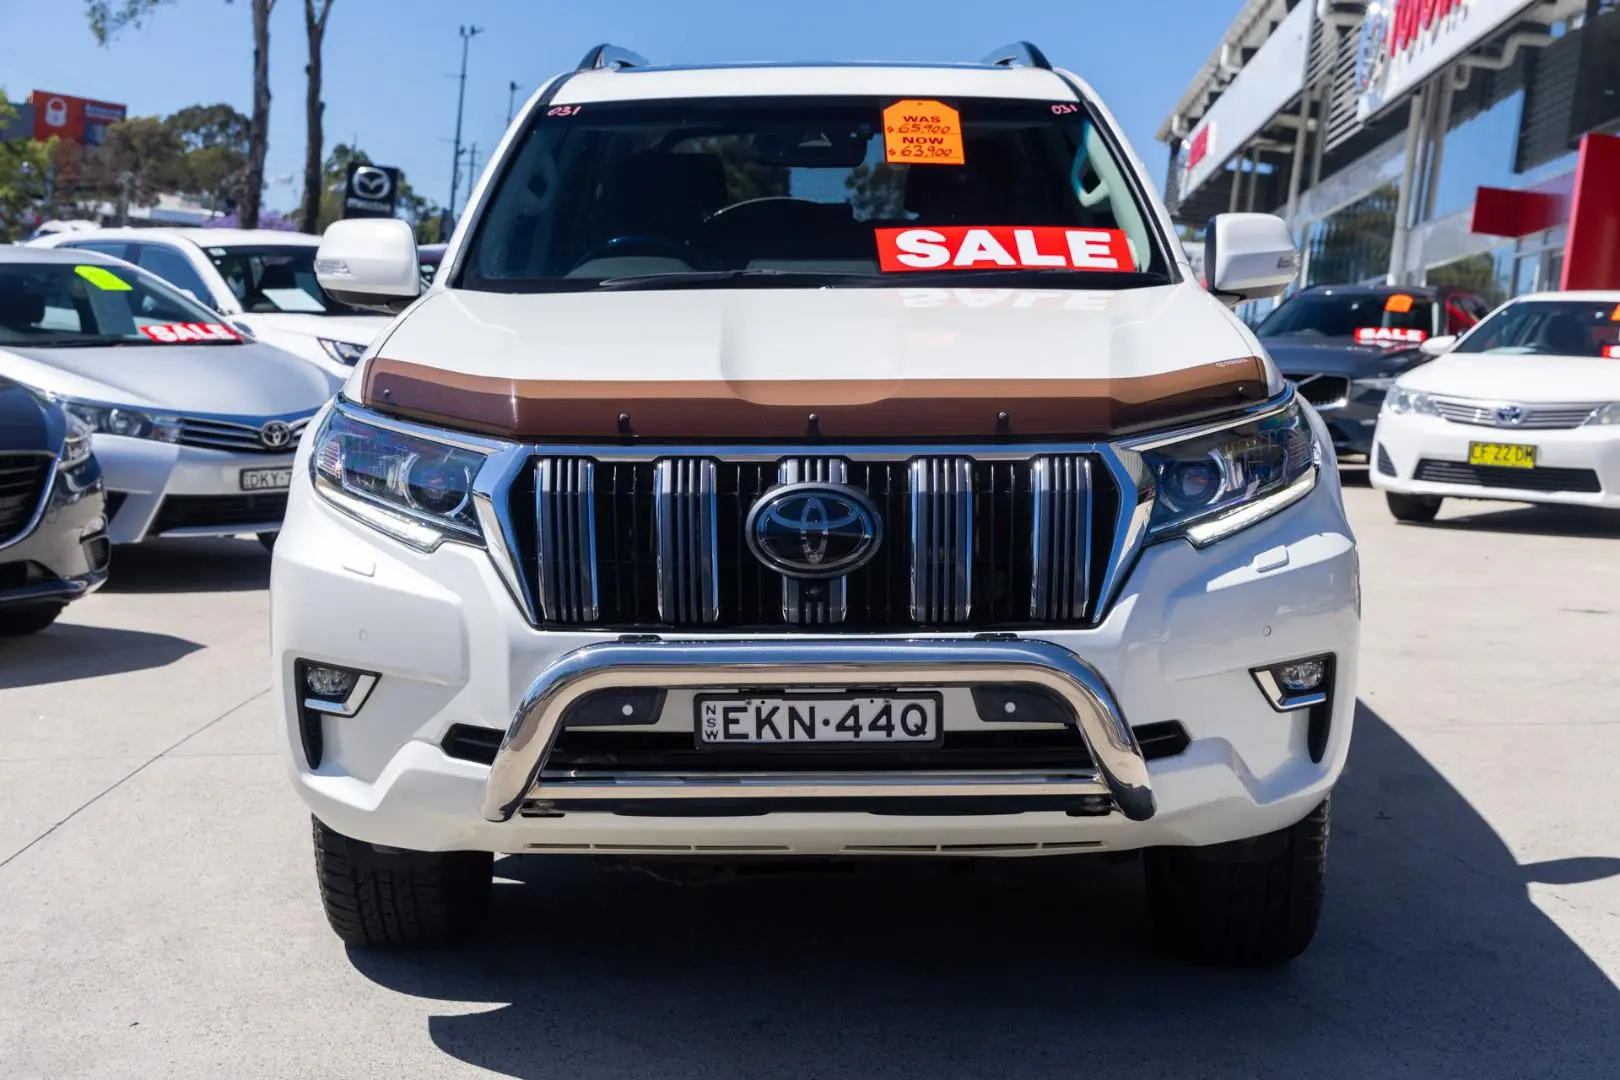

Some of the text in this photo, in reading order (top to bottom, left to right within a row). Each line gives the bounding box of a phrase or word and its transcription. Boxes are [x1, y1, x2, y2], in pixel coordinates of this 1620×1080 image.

[1051, 104, 1078, 115] 031
[902, 115, 941, 123] WAS
[902, 136, 944, 145] NOW
[895, 229, 1119, 269] SALE
[147, 324, 237, 342] SALE
[1360, 327, 1422, 341] SALE
